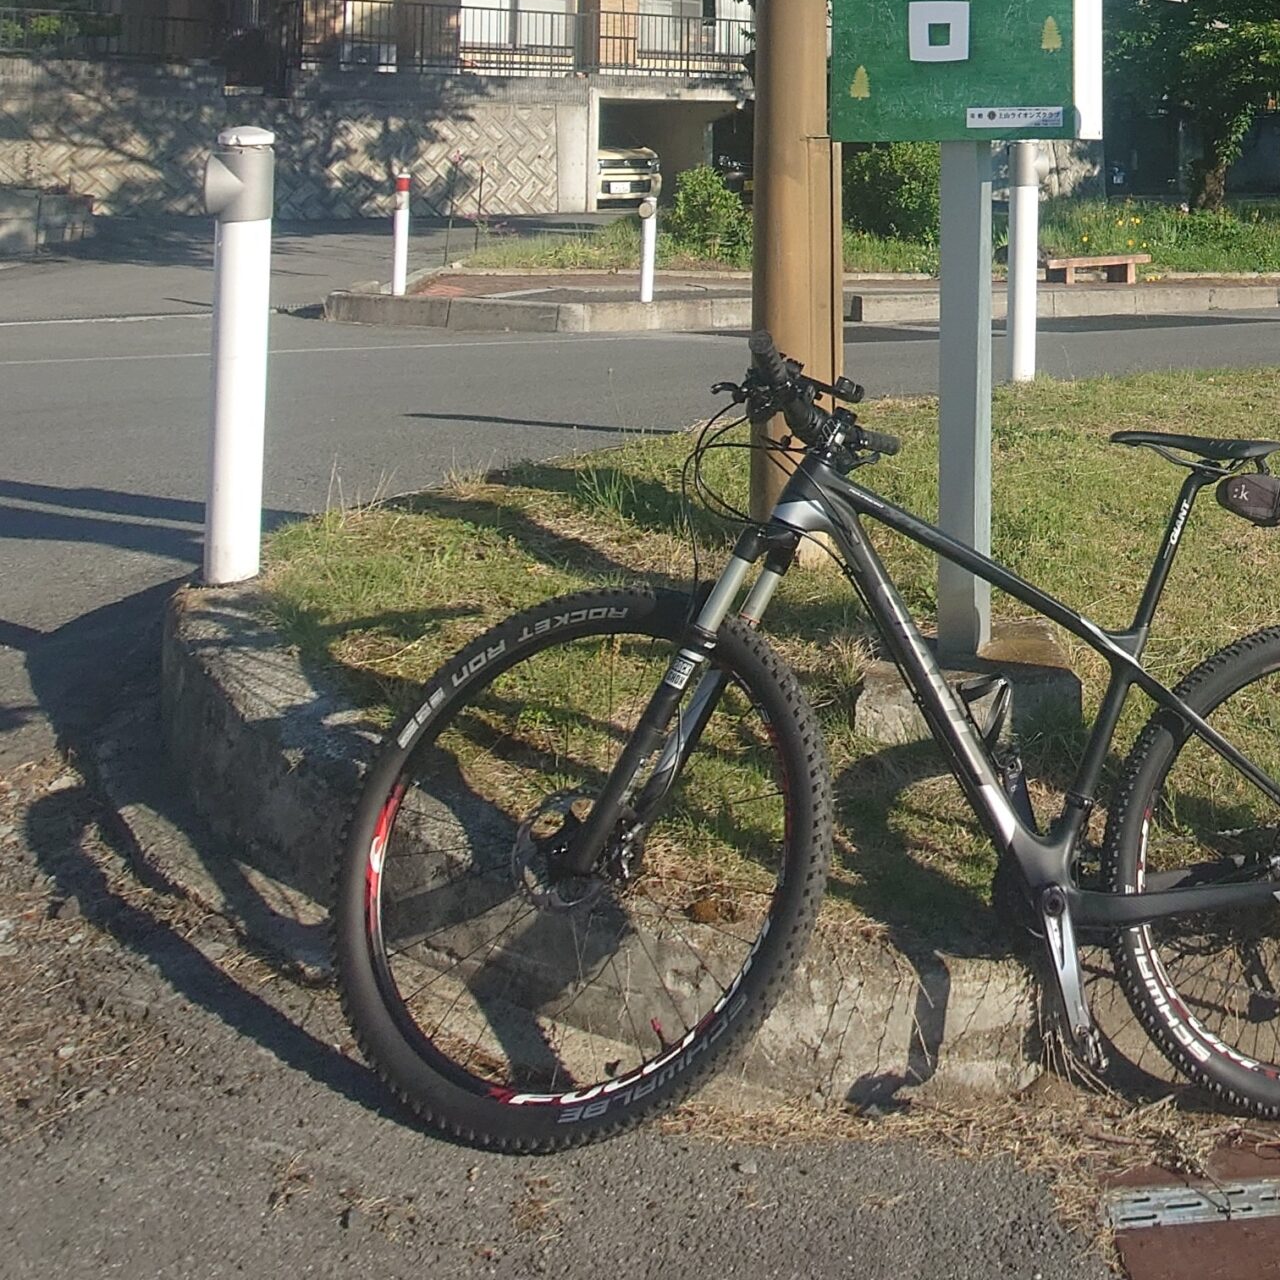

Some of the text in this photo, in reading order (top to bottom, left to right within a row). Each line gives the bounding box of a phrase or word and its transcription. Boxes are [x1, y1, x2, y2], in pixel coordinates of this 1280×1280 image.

[1170, 499, 1190, 545] GIANT
[450, 606, 629, 688] ROCKET RON
[556, 992, 749, 1124] SCHWALBE
